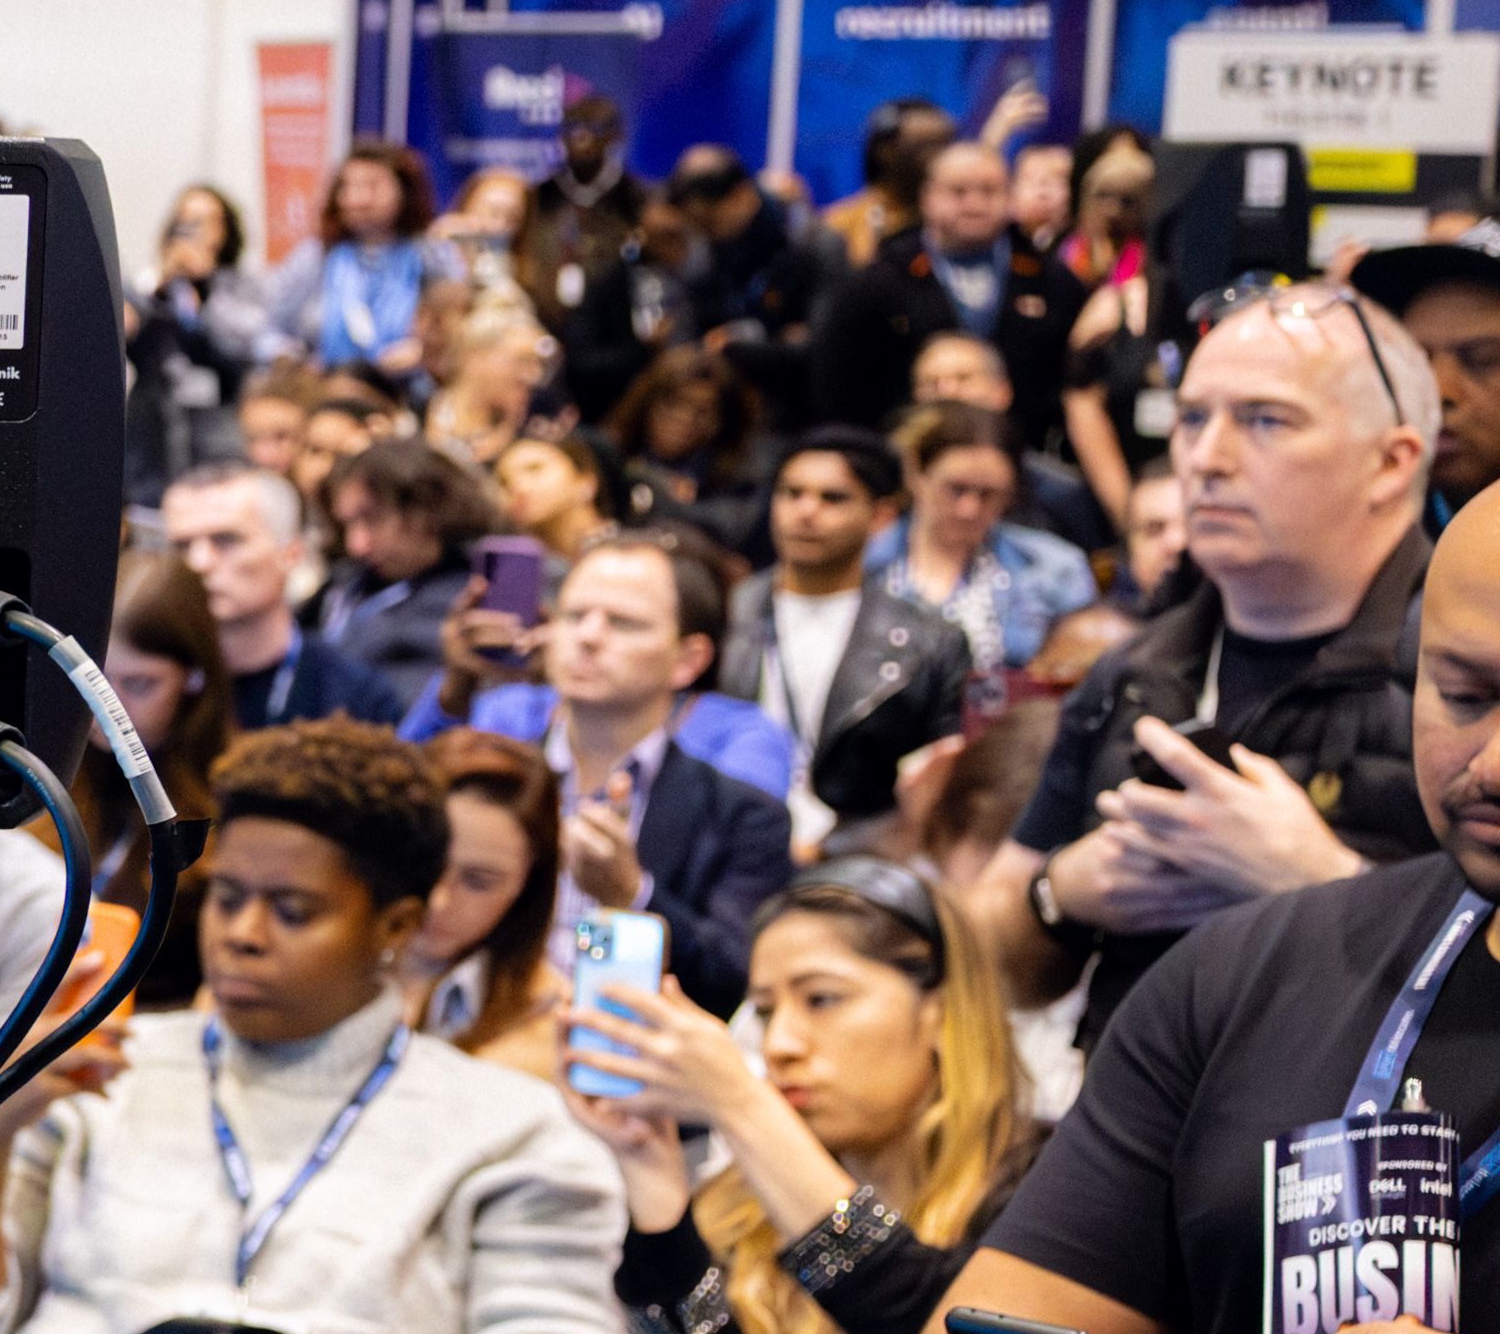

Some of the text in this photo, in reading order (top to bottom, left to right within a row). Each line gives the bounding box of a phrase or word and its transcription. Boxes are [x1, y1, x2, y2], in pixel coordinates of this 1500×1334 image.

[1220, 55, 1438, 100] KEYNOTE
[1346, 1129, 1367, 1142] YOU
[1368, 1124, 1399, 1140] NEED
[1401, 1124, 1419, 1136] TO
[1377, 1159, 1434, 1172] SPONSORED
[1278, 1173, 1344, 1205] BUSINESS
[1369, 1178, 1407, 1194] DELL
[1420, 1177, 1452, 1197] intel
[1278, 1198, 1318, 1226] SHOW
[1309, 1215, 1456, 1248] DISCOVER THE
